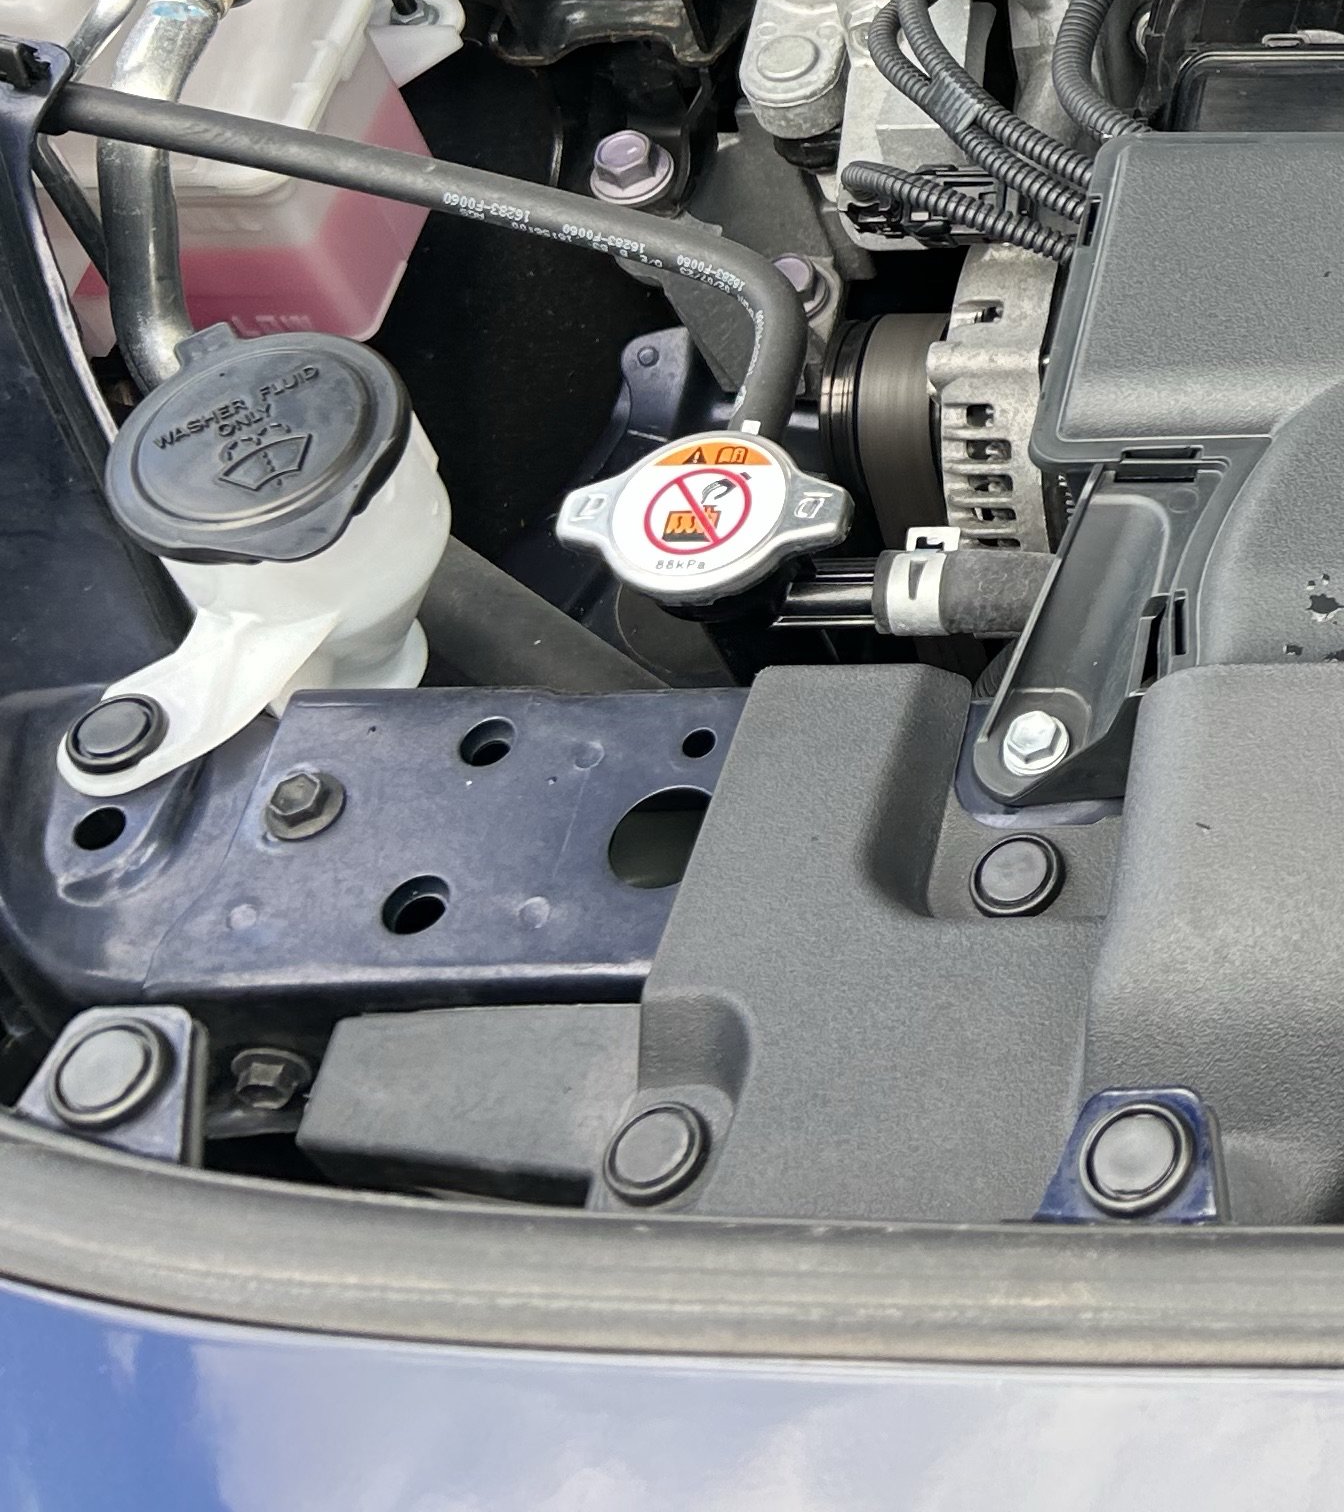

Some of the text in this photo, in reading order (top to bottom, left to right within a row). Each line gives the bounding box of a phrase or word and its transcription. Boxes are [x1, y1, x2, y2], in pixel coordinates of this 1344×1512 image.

[441, 190, 531, 223] 16283-F0060
[151, 364, 321, 451] WASHER FLUID
[216, 402, 272, 438] ONLY
[655, 558, 706, 571] 88kPa
